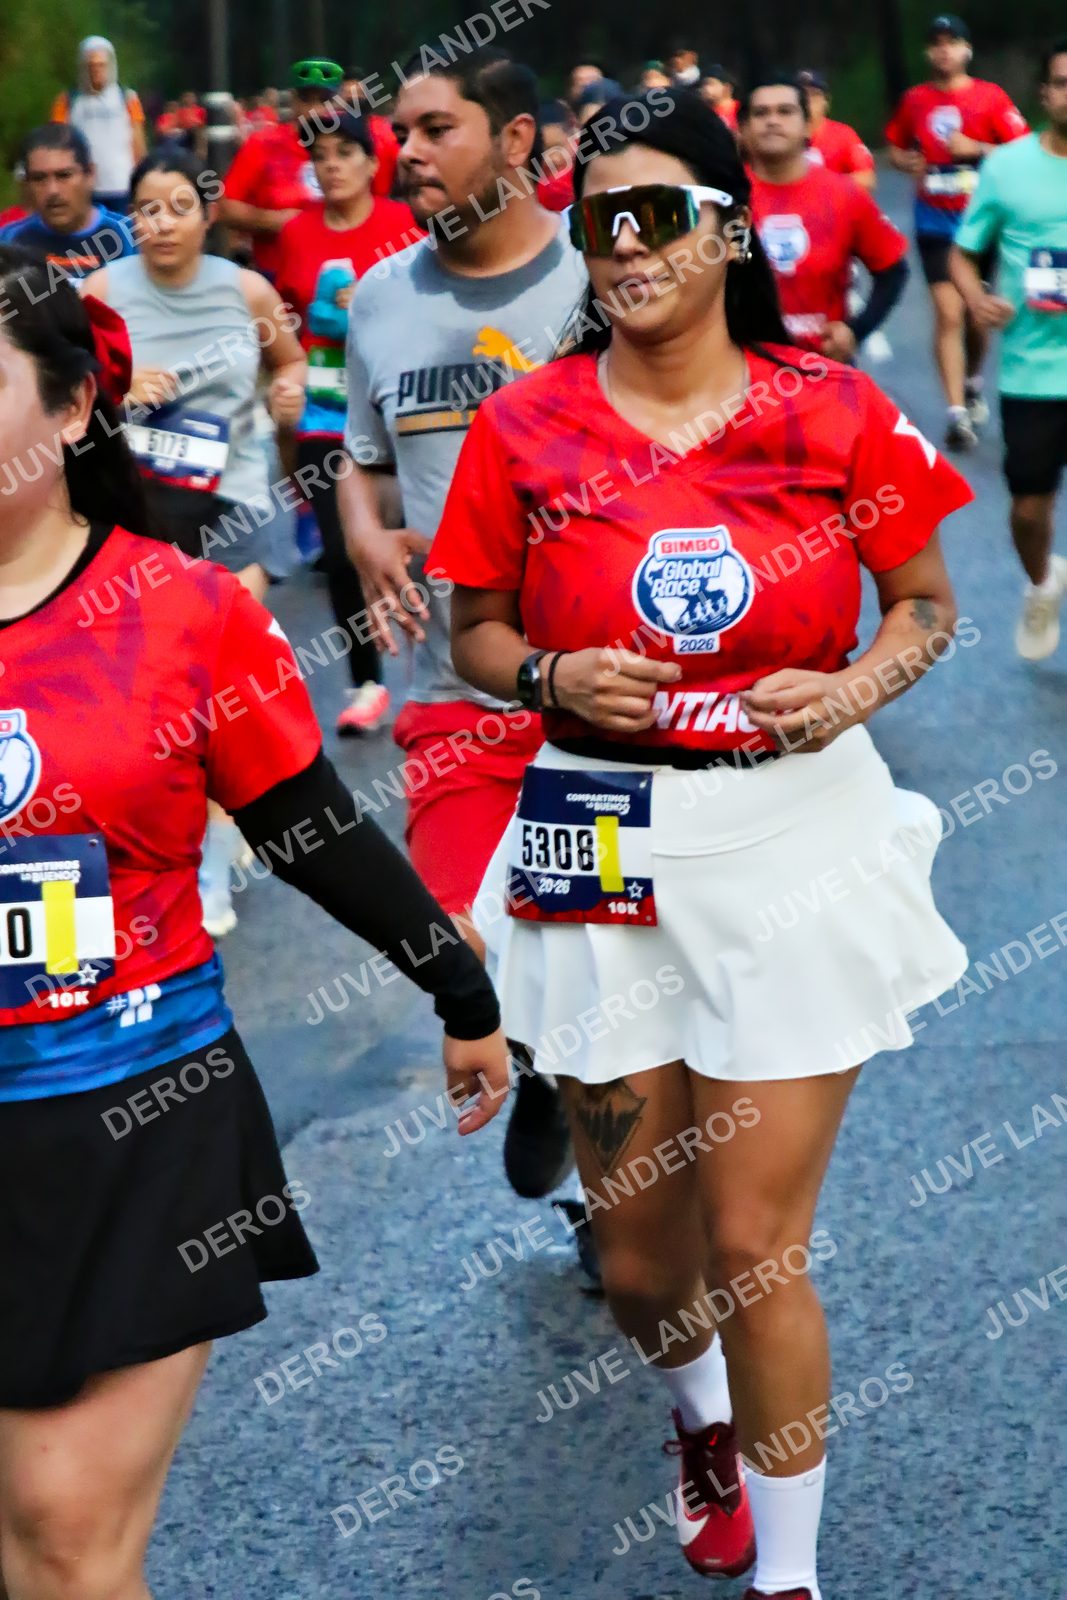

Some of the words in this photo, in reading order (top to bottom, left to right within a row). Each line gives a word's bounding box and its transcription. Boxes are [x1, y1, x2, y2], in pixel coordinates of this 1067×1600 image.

[661, 538, 720, 554] BIMBO
[662, 557, 722, 580] Global
[651, 578, 701, 599] Race
[679, 637, 715, 652] 2026
[522, 824, 595, 872] 5308
[608, 901, 640, 915] 10K
[50, 990, 90, 1009] 10K
